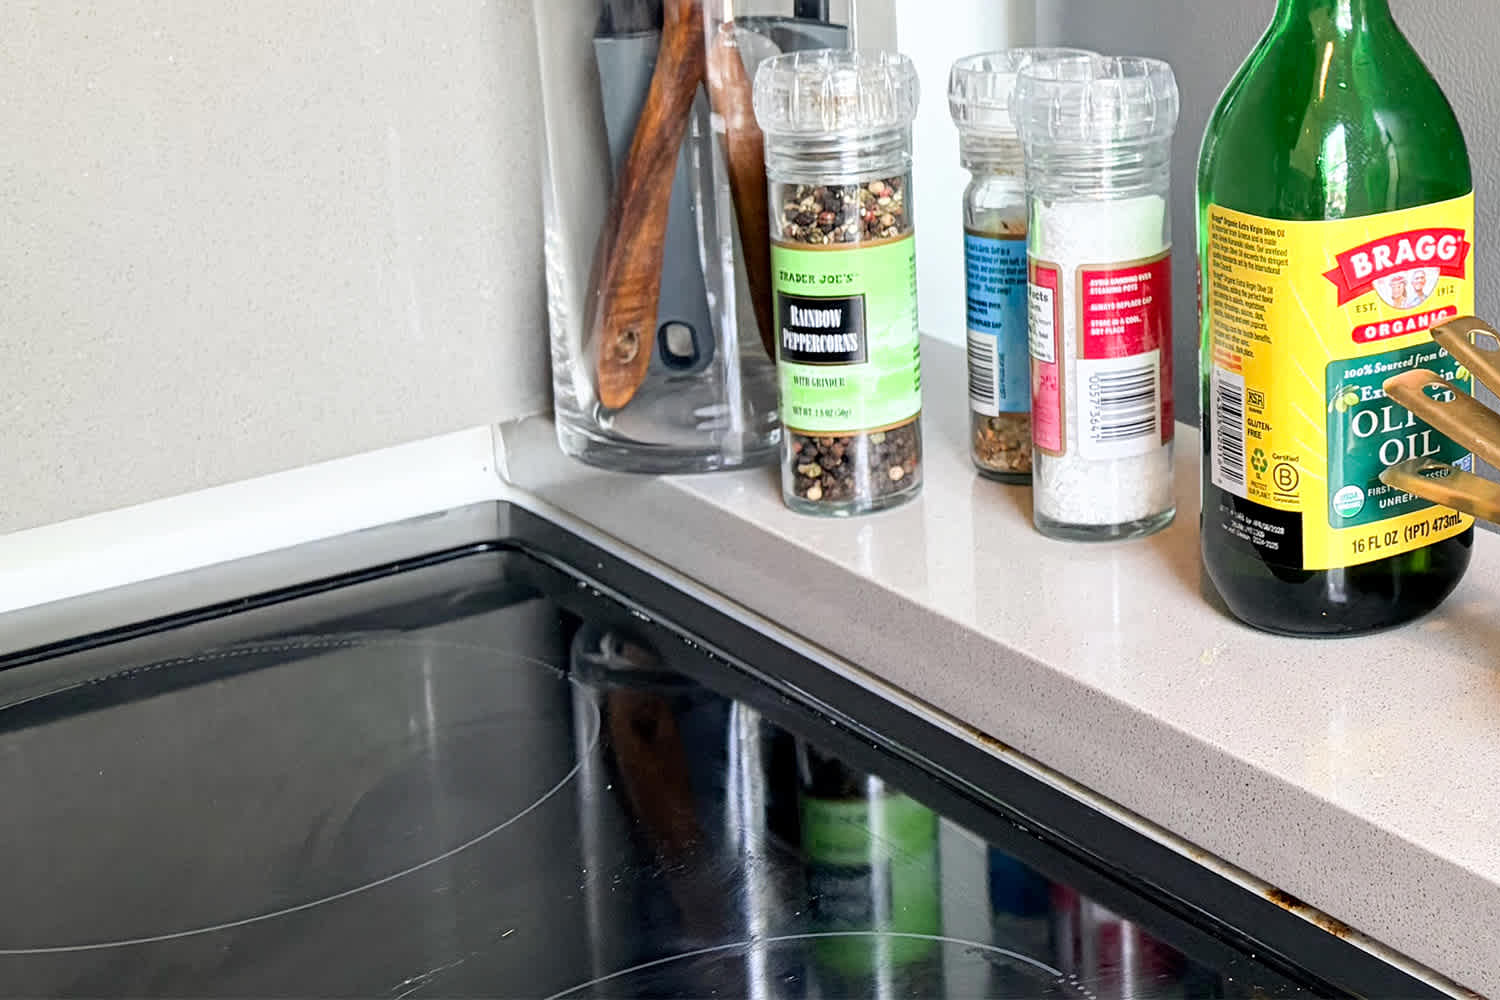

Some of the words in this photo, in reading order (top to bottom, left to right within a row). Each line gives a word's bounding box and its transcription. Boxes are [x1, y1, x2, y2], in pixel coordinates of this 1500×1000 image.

[1350, 235, 1457, 279] BRAGG
[779, 271, 815, 284] TRADER
[790, 304, 842, 328] RAINBOW
[1355, 302, 1377, 313] EST.
[1364, 310, 1447, 339] ORGANIC
[783, 327, 858, 353] PEPPERCORNS
[1344, 364, 1372, 379] 100%
[1374, 355, 1414, 373] Sourced
[1413, 351, 1437, 368] from
[793, 376, 810, 387] WITH
[1247, 418, 1272, 432] GLUTEN-
[1248, 427, 1262, 440] FREE
[1272, 452, 1299, 462] Certified
[1379, 430, 1440, 466] OIL
[1368, 484, 1390, 497] FIRST
[1352, 539, 1365, 553] 16
[1368, 535, 1381, 551] FL
[1384, 530, 1399, 546] OZ
[1403, 519, 1430, 542] (1PT)
[1432, 511, 1463, 532] 473mL
